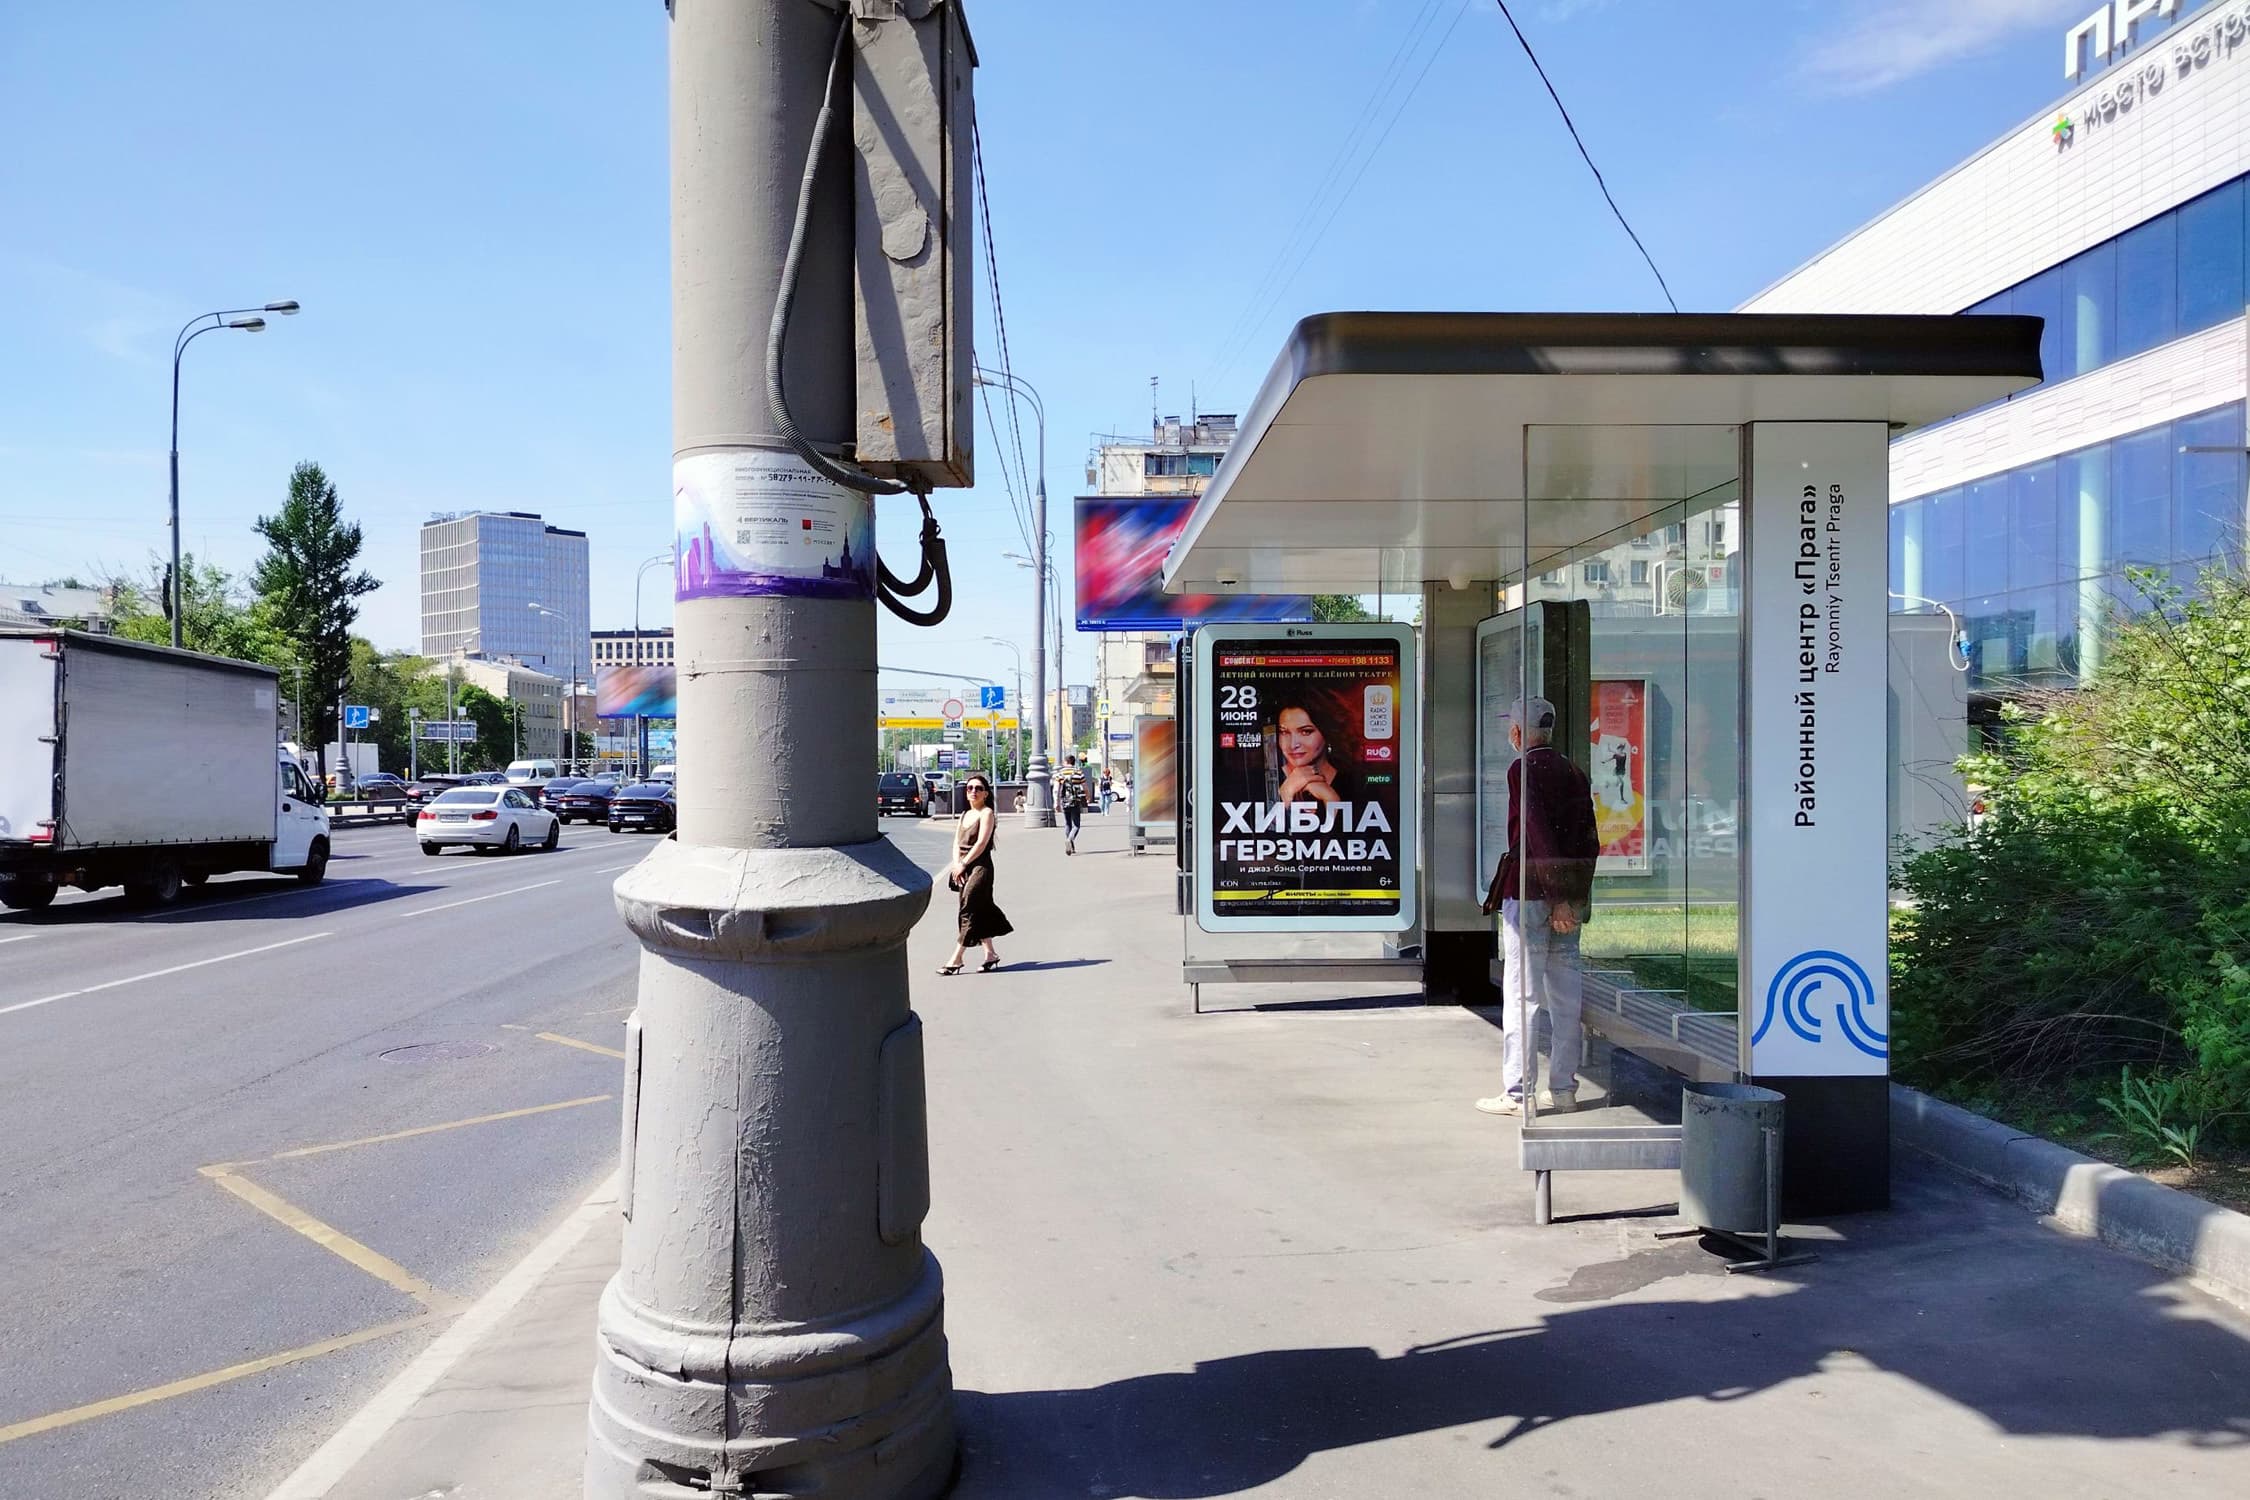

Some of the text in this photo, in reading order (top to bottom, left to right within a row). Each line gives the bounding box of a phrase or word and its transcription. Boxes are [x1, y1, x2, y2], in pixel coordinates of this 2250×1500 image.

[2065, 0, 2174, 79] ПР
[1825, 484, 1844, 673] Rayonniy Tsentr Praga
[1352, 656, 1367, 665] 198
[1369, 656, 1390, 664] 1133
[1794, 484, 1821, 827] Районный центр «Прага»
[1219, 670, 1256, 680] ЛЕТНИЙ
[1259, 671, 1302, 679] КОНЦЕРТ
[1312, 670, 1356, 678] ЗЕЛЁНОМ
[1220, 685, 1257, 709] 28
[1220, 711, 1258, 721] ИЮНЯ
[1367, 775, 1390, 783] metro
[1220, 801, 1392, 834] ХИБЛА
[1219, 839, 1392, 862] ГЕРЗМАВА
[1247, 864, 1297, 874] джаз-бэнд
[1298, 864, 1330, 874] Сергея
[1332, 864, 1373, 873] Макеева
[1379, 876, 1393, 887] 6+
